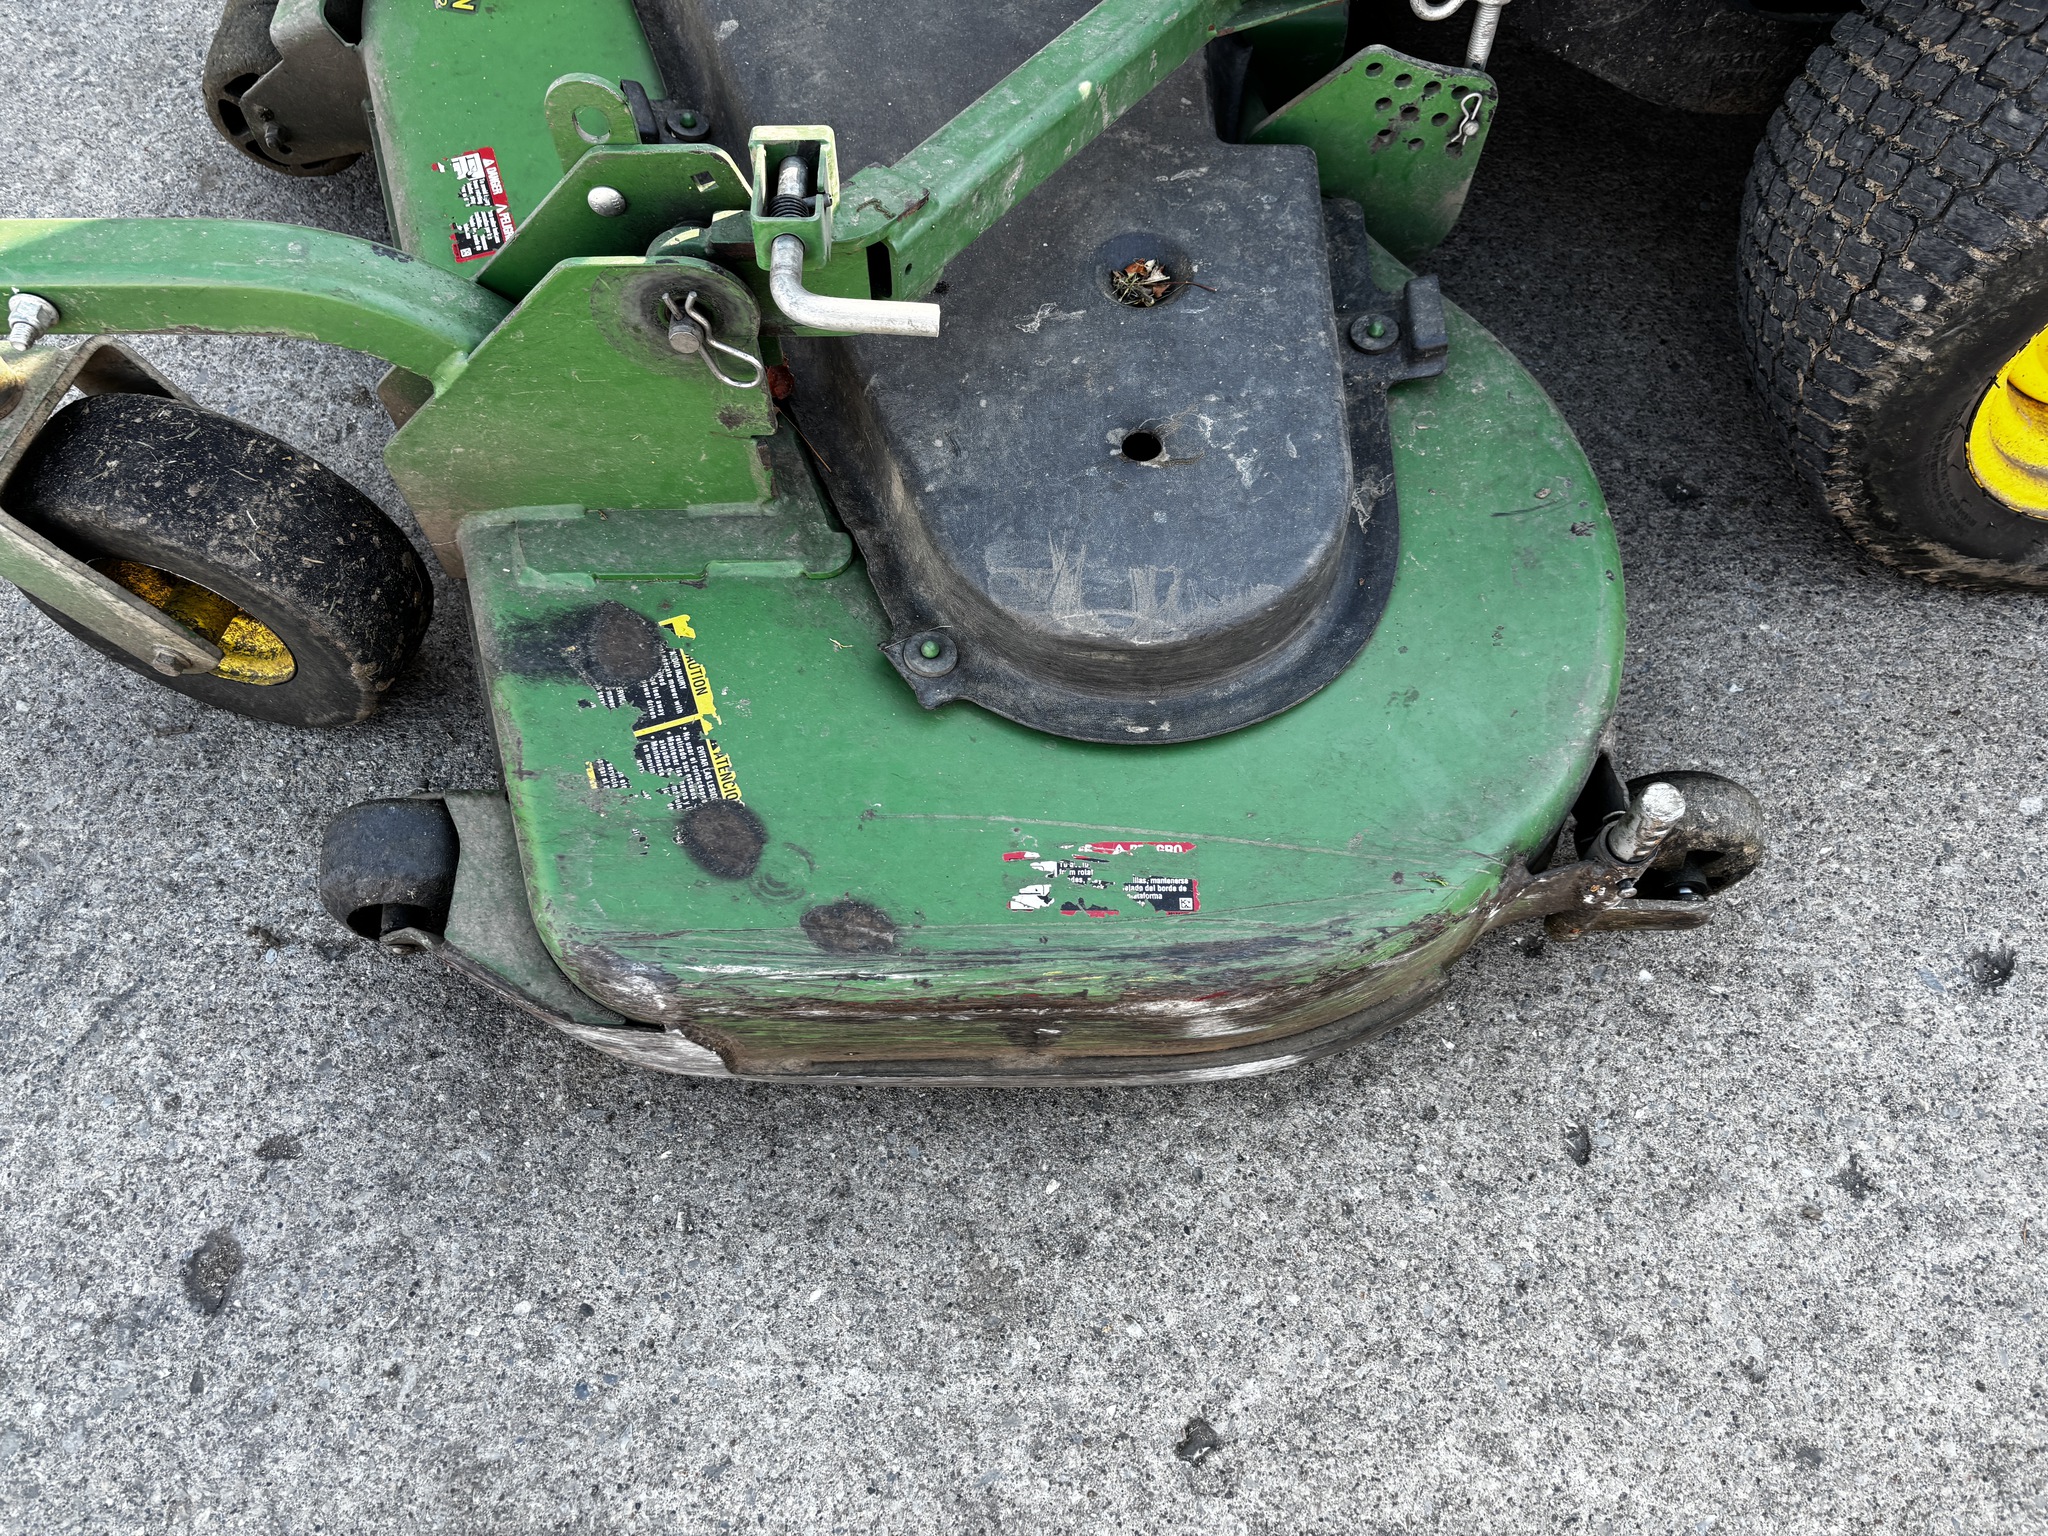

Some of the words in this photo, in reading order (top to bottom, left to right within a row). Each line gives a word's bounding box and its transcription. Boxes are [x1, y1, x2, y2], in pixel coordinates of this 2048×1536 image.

[486, 166, 502, 195] DANGER
[685, 653, 707, 696] AUTION
[615, 685, 627, 705] ERVIC
[667, 678, 678, 700] mower
[673, 699, 684, 714] with
[646, 698, 658, 719] driven
[653, 699, 665, 716] away
[681, 730, 691, 741] No
[649, 739, 666, 777] Mantenerse
[657, 738, 672, 767] alejados
[666, 735, 681, 766] Mantener
[674, 733, 688, 760] retirado
[681, 760, 690, 773] sus
[684, 740, 695, 756] usar
[695, 744, 709, 767] EVITAR
[595, 757, 606, 777] pagar
[644, 752, 656, 775] movim
[713, 749, 738, 801] ATENCIO
[1129, 844, 1182, 852] PGRO
